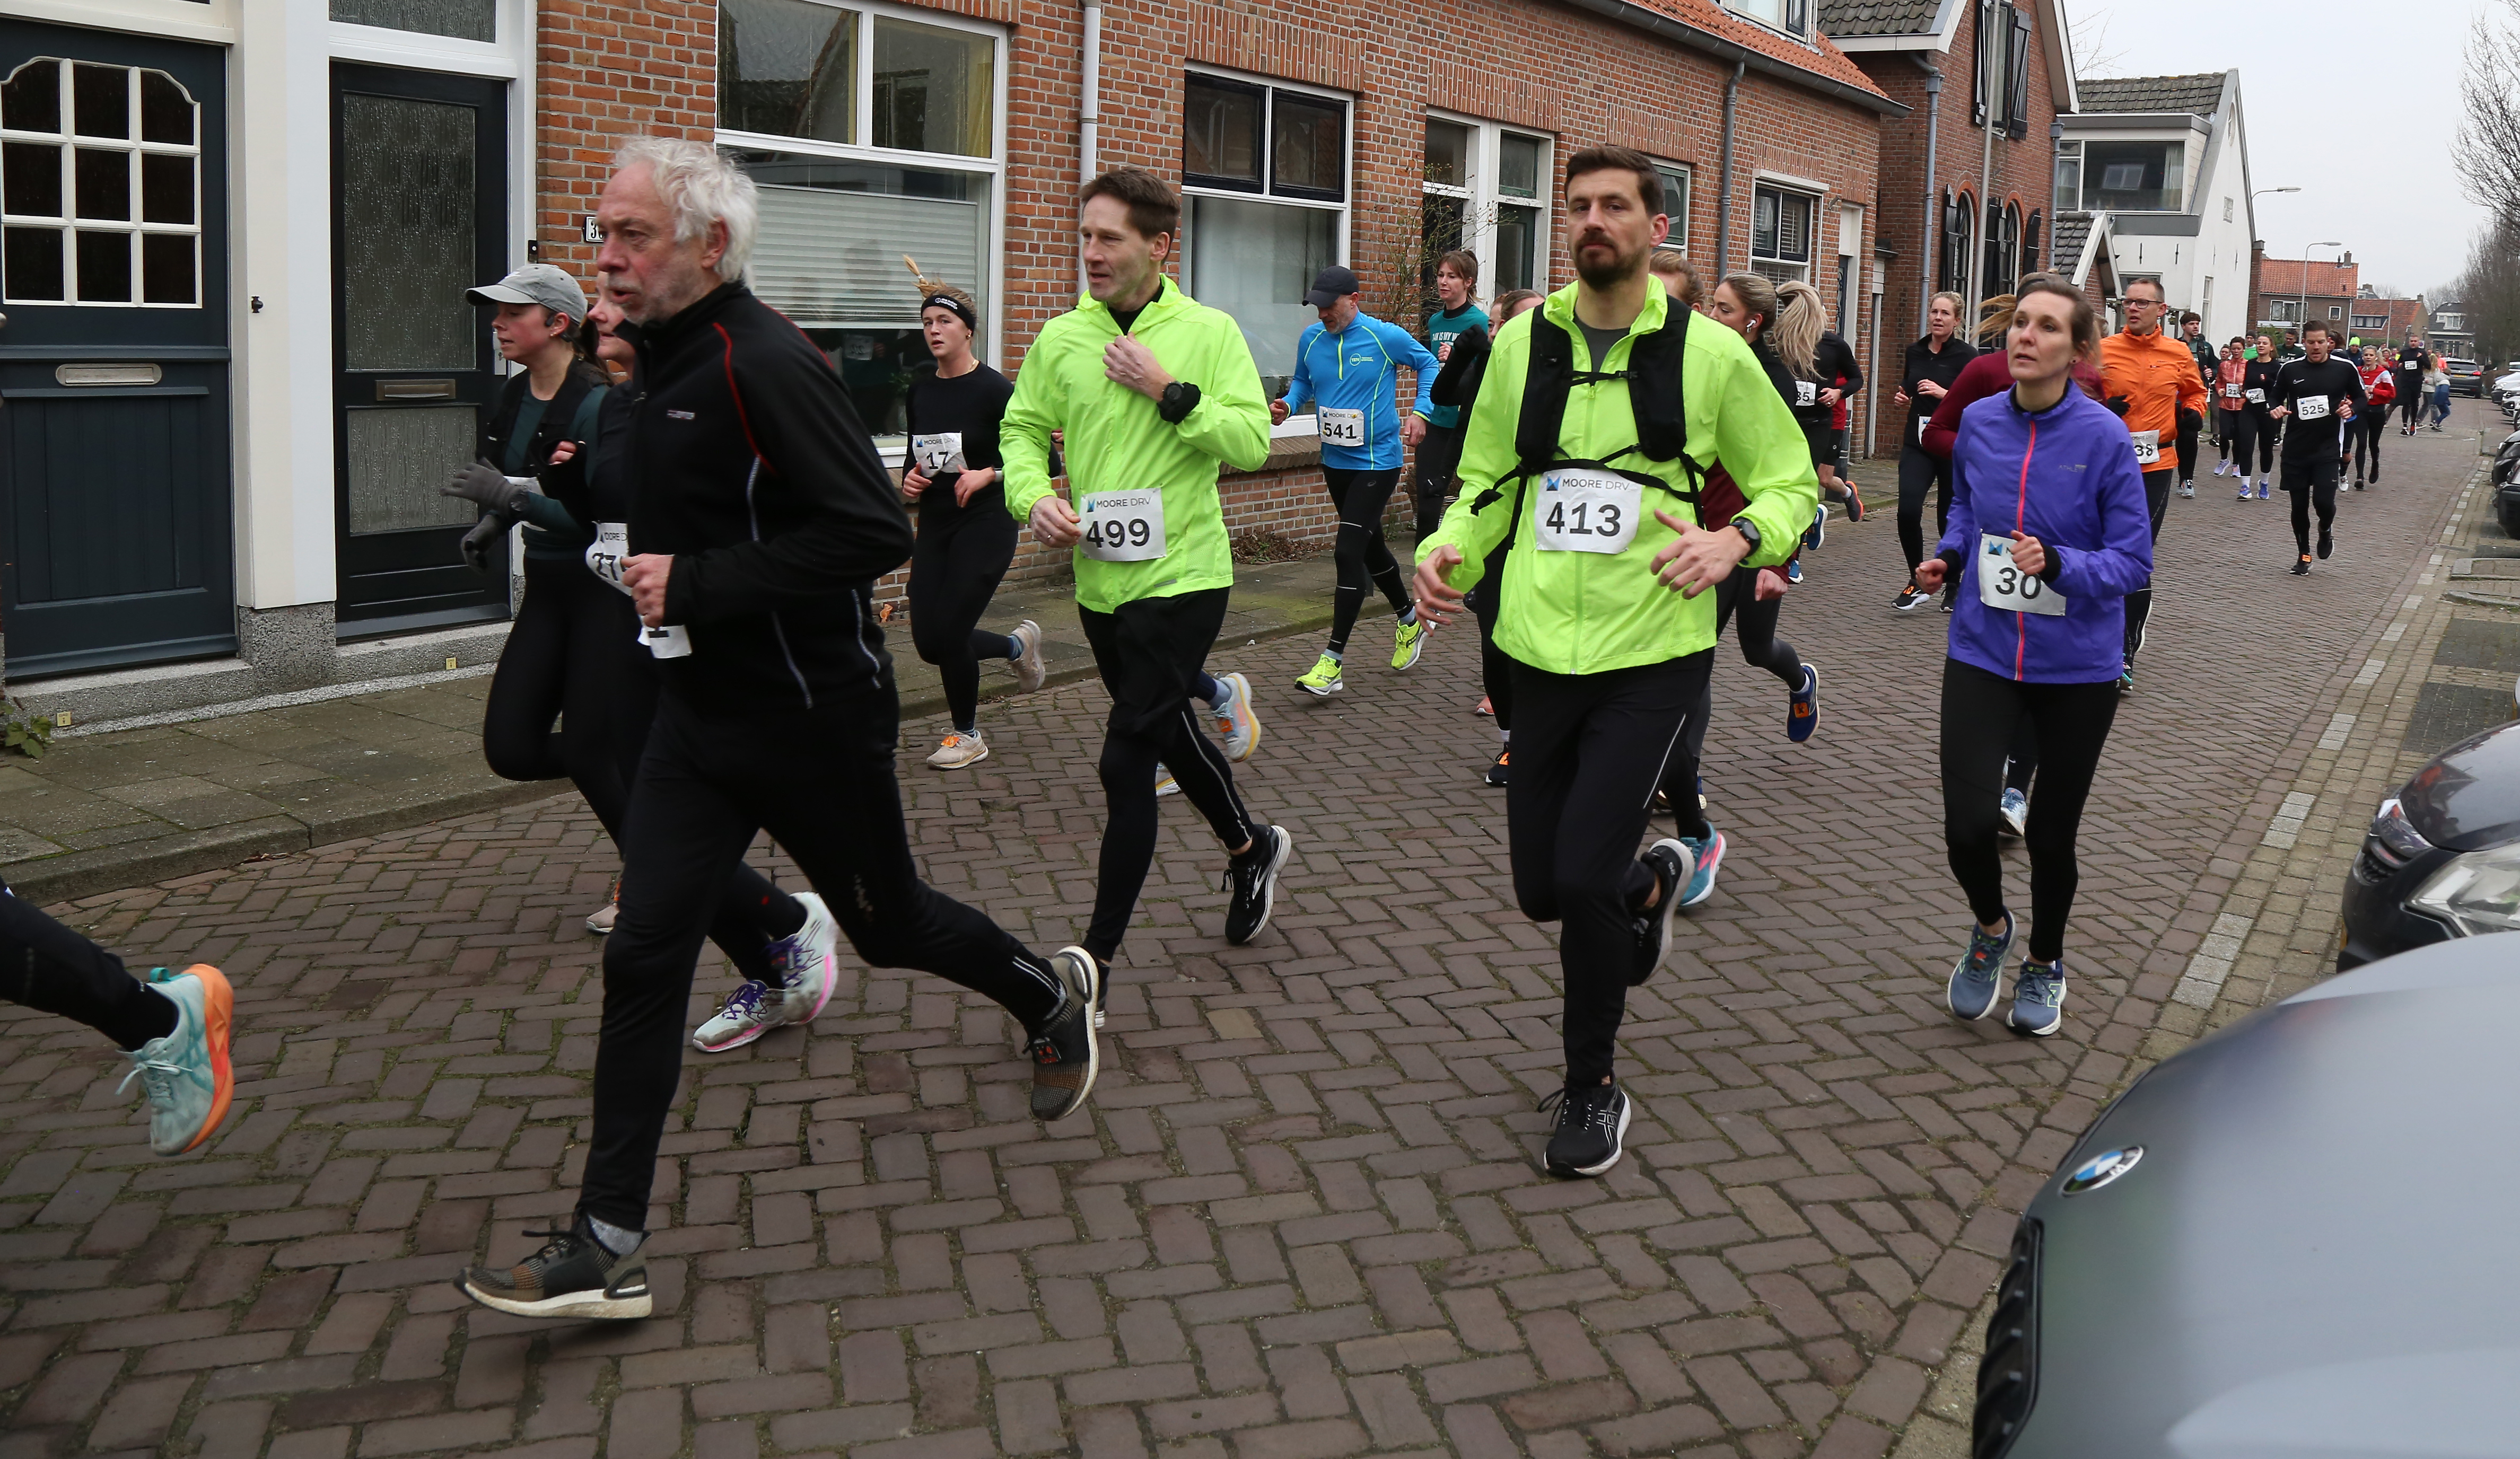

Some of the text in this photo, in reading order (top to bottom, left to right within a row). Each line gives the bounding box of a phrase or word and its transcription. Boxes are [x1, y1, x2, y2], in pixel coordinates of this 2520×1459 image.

[2302, 404, 2325, 416] 525
[1324, 422, 1357, 439] 541
[926, 451, 949, 470] 17
[1562, 478, 1630, 490] MOORE DRV
[1096, 497, 1151, 508] MOORE DRV
[1546, 502, 1621, 537] 413
[1086, 518, 1150, 548] 499
[1996, 567, 2041, 600] 30
